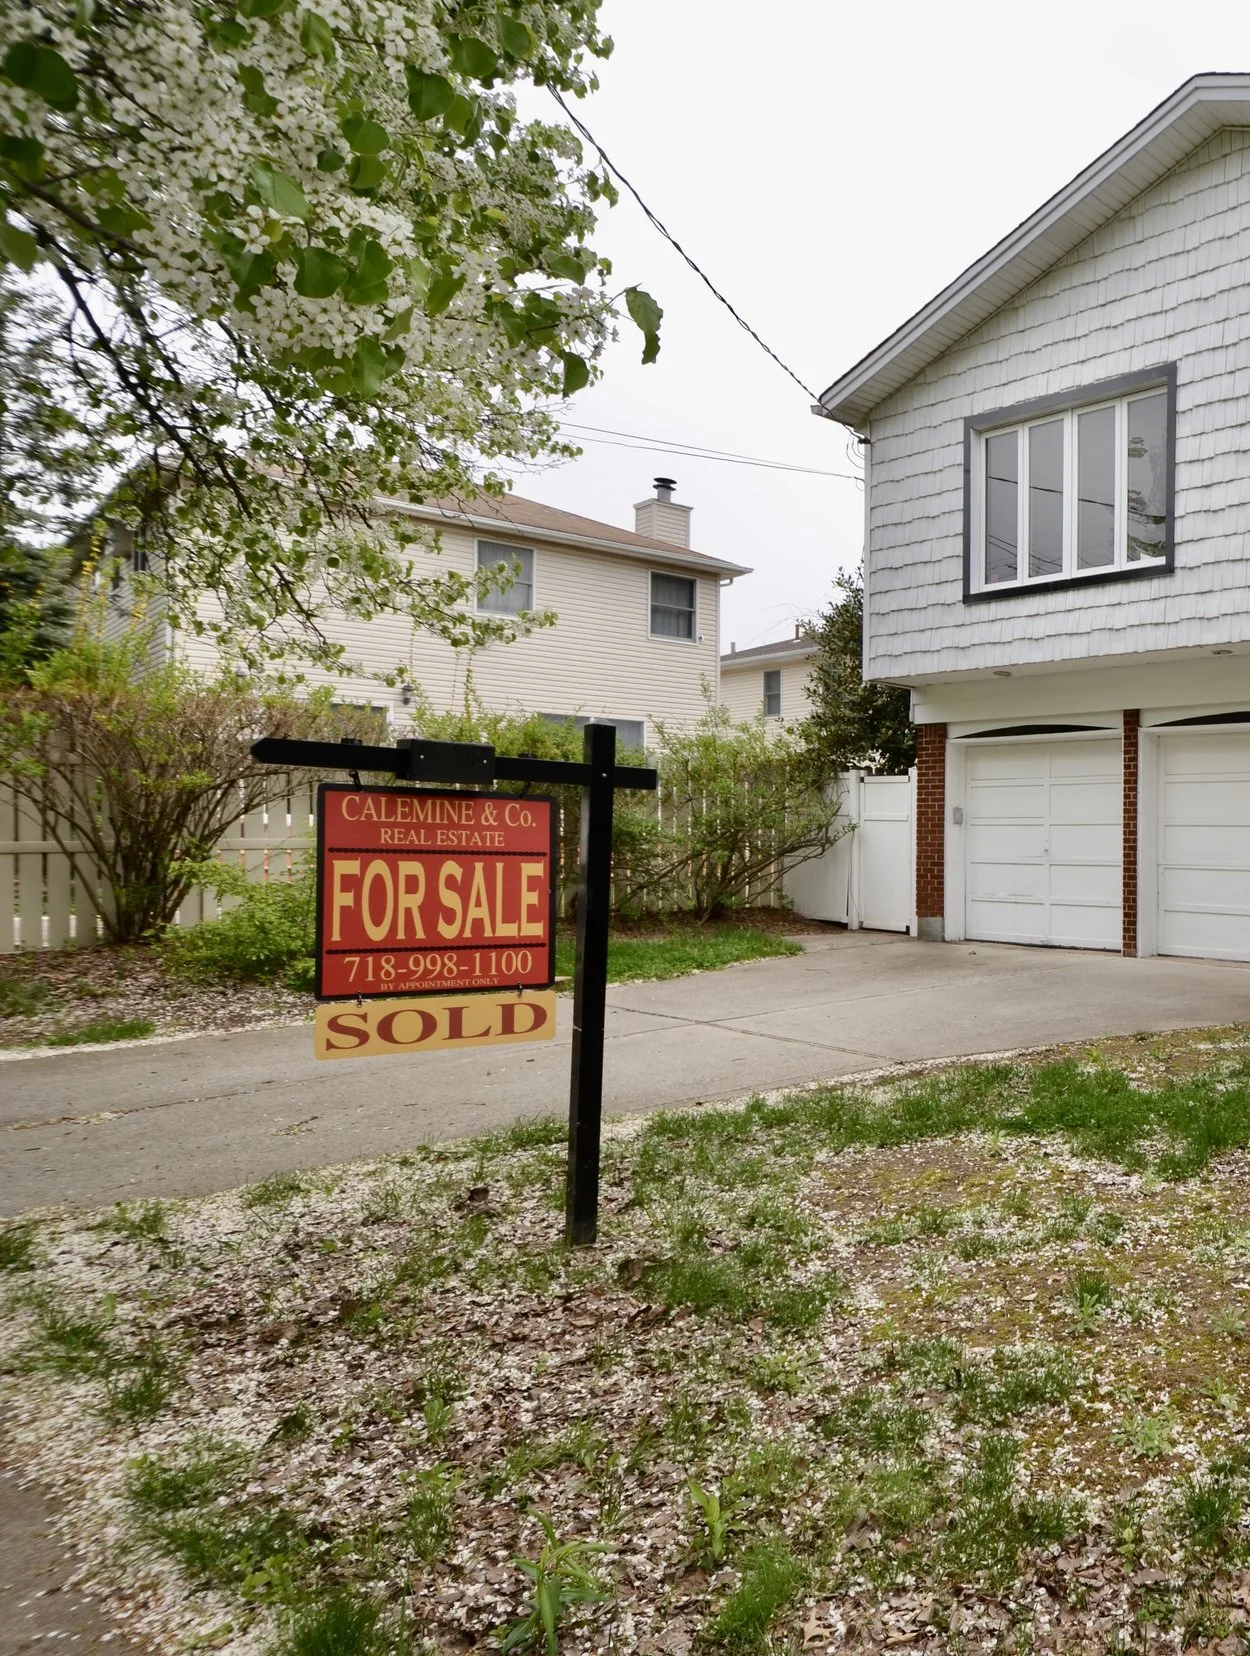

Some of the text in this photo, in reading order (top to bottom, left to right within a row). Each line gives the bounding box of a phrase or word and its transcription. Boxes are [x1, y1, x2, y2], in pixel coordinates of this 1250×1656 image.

[341, 795, 537, 827] CALEMINE & Co.
[379, 828, 505, 847] REAL ESTATE
[330, 857, 545, 942] FOR SALE
[343, 950, 533, 983] 718-998-1100
[380, 977, 500, 991] BY APPOINTMENT ONLY
[325, 1002, 548, 1052] SOLD
